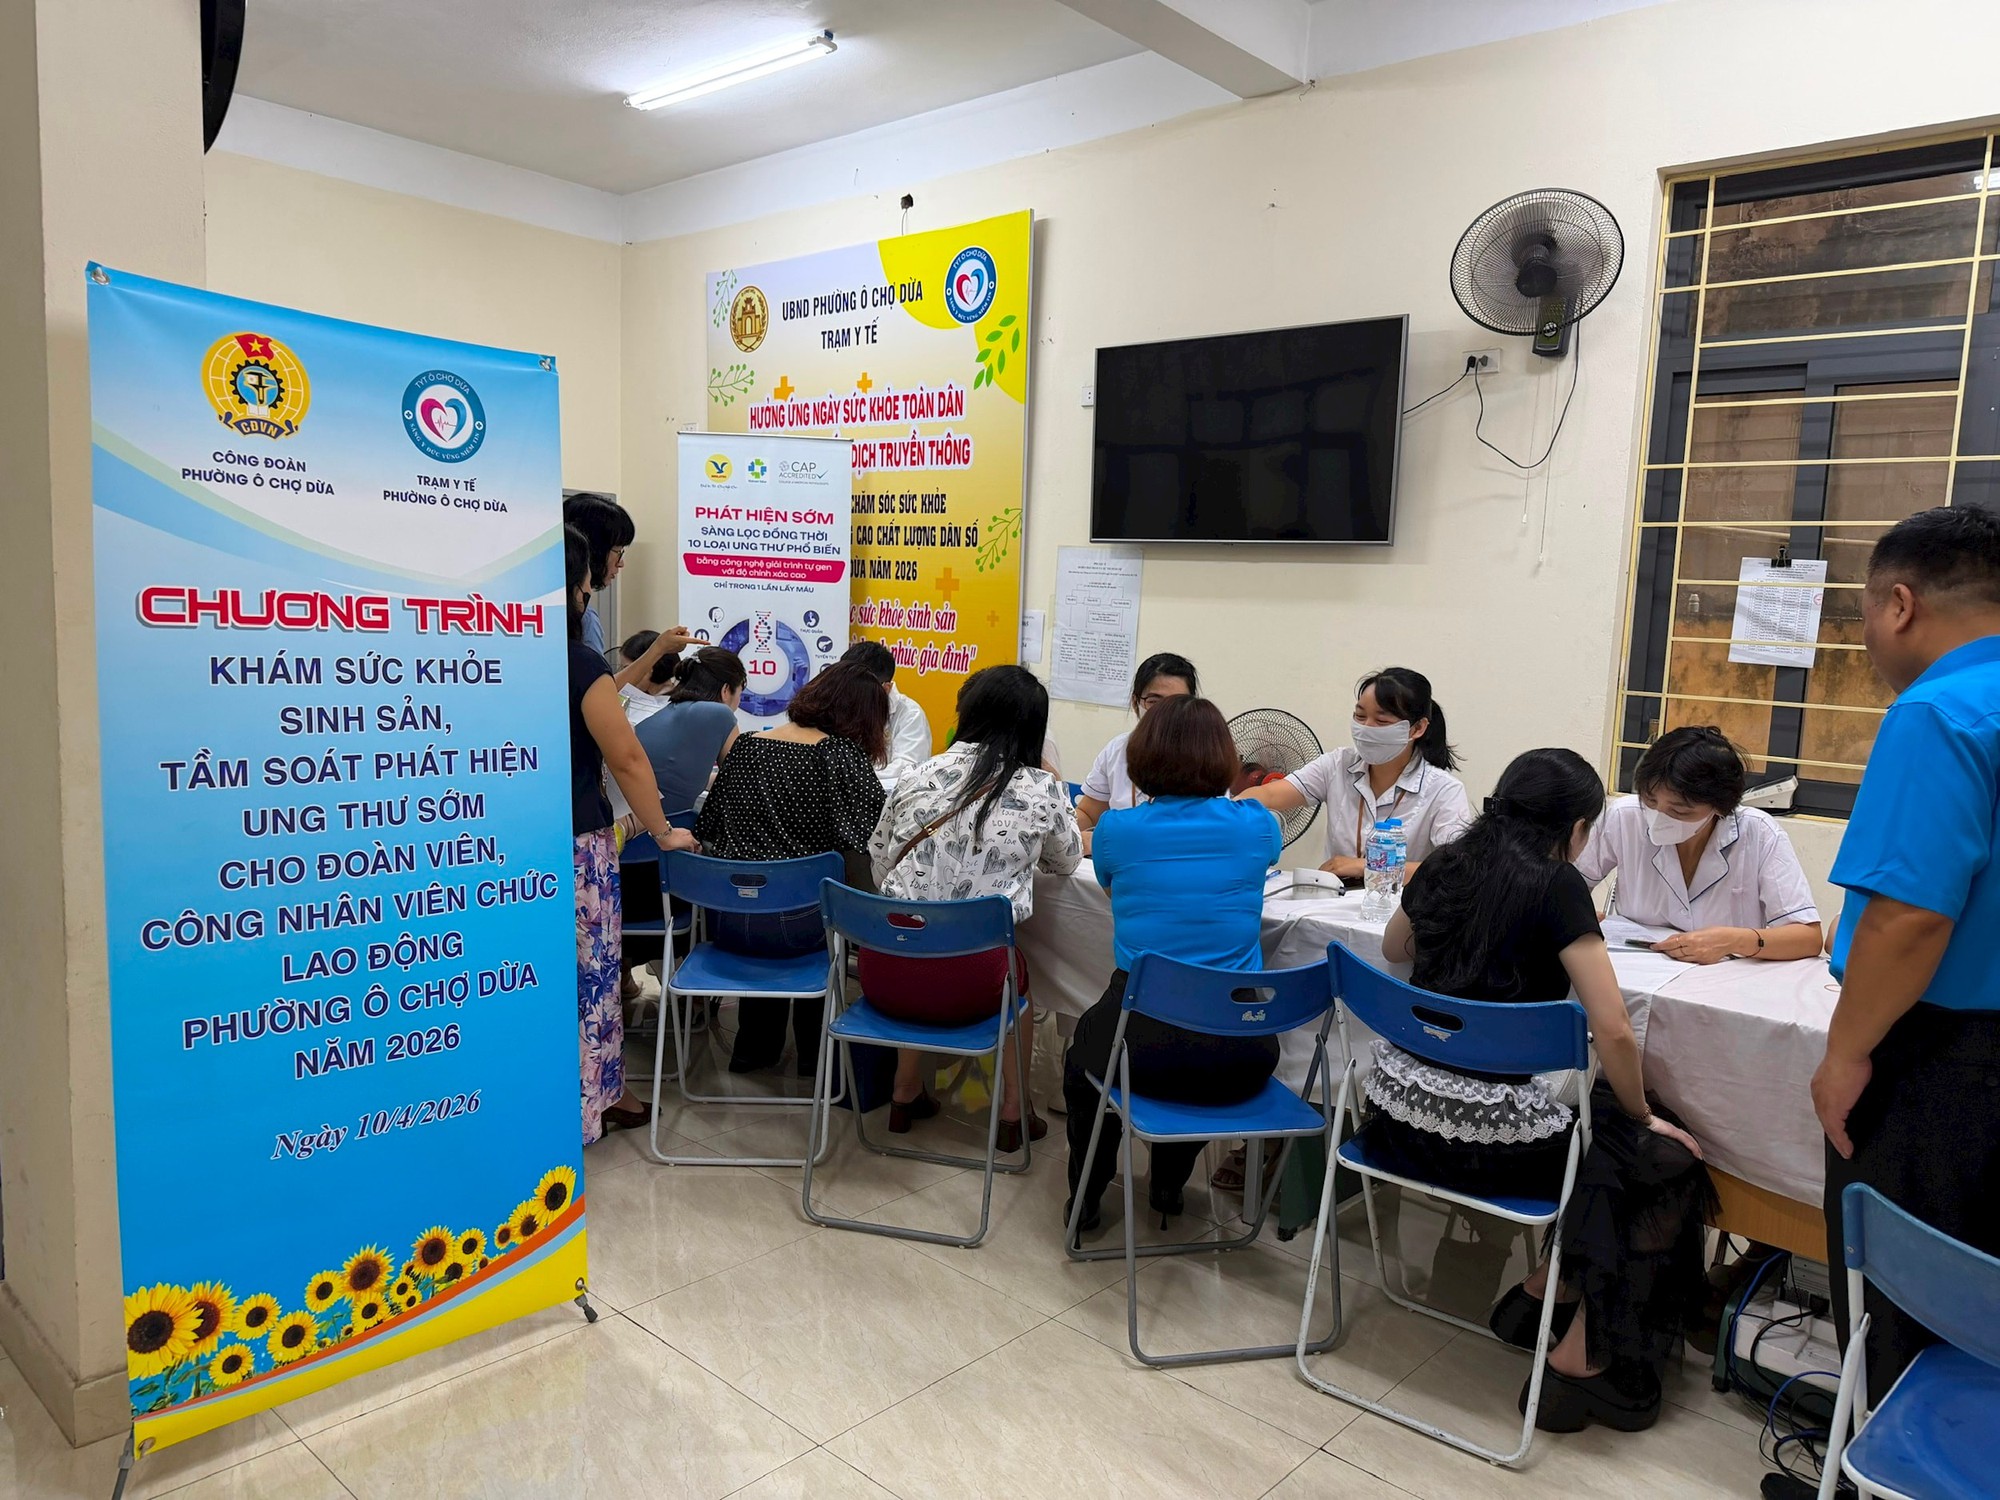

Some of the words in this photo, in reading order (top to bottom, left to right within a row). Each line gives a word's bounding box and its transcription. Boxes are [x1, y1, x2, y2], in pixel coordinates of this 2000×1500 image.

[783, 300, 810, 322] UBND
[813, 288, 856, 317] PHƯỜNG
[861, 284, 868, 309] Ô
[872, 282, 897, 310] CHỢ
[900, 275, 924, 303] DỪA
[821, 329, 851, 352] TRẠM
[854, 327, 862, 345] Y
[865, 318, 878, 344] TẾ
[415, 376, 428, 388] TYT
[428, 373, 435, 381] Ô
[436, 373, 454, 382] CHỢ
[454, 379, 470, 394] DỪA
[788, 397, 810, 427] ỨNG
[813, 394, 840, 425] NGÀY
[843, 392, 866, 424] SỨC
[870, 387, 900, 422] KHỎE
[902, 386, 934, 420] TOÀN
[938, 384, 964, 417] DÂN
[240, 420, 279, 438] CĐVN
[212, 450, 259, 466] CÔNG
[264, 457, 306, 472] ĐOÀN
[791, 462, 817, 472] CAP
[852, 443, 876, 475] DỊCH
[879, 430, 926, 468] TRUYỀN
[928, 432, 970, 466] THÔNG
[182, 468, 248, 485] PHƯỜNG
[253, 473, 264, 487] Ô
[269, 478, 302, 494] CHỢ
[306, 479, 335, 495] DỪA
[416, 474, 449, 491] TRẠM
[452, 478, 461, 489] Y
[463, 476, 477, 492] TẾ
[779, 472, 817, 480] ACCREDITED
[383, 489, 438, 507] PHƯỜNG
[440, 492, 450, 507] Ô
[453, 496, 481, 513] CHỢ
[483, 496, 508, 513] DỪA
[695, 505, 742, 520] PHÁT
[746, 507, 788, 525] HIỆN
[792, 509, 834, 525] SỚM
[878, 490, 896, 514] SÓC
[899, 490, 917, 514] SỨC
[920, 487, 946, 514] KHỎE
[688, 540, 702, 548] 10
[704, 540, 730, 551] LOẠI
[733, 542, 758, 551] UNG
[760, 543, 786, 552] THƯ
[786, 541, 811, 554] PHỔ
[814, 544, 841, 555] BIẾN
[701, 525, 734, 537] SÀNG
[737, 528, 760, 540] LỌC
[800, 530, 828, 542] THỜI
[856, 526, 874, 546] CAO
[877, 518, 900, 546] CHẤT
[904, 526, 936, 550] LƯỢNG
[940, 522, 962, 547] DÂN
[965, 518, 978, 548] SỐ
[720, 558, 742, 567] công
[744, 560, 764, 569] nghệ
[783, 561, 803, 570] trình
[805, 562, 814, 570] tự
[816, 564, 832, 572] gen
[736, 568, 746, 577] độ
[749, 568, 772, 578] chính
[772, 570, 788, 578] xác
[869, 556, 892, 580] NĂM
[895, 560, 917, 581] 2026
[729, 582, 756, 590] TRONG
[796, 585, 814, 593] MÁU
[139, 586, 390, 632] CHƯƠNG
[405, 592, 545, 635] TRÌNH
[858, 599, 876, 625] sức
[878, 600, 904, 627] khỏe
[906, 602, 931, 630] sinh
[934, 604, 956, 632] sản
[210, 650, 322, 686] KHÁM
[335, 650, 403, 686] SỨC
[415, 649, 502, 685] KHỎE
[748, 660, 776, 676] 10
[920, 642, 938, 674] gia
[279, 705, 365, 735] SINH
[376, 695, 453, 735] SẢN,
[160, 747, 248, 792] TẦM
[263, 744, 362, 787] SOÁT
[374, 744, 459, 780] PHÁT
[470, 741, 538, 778] HIỆN
[242, 805, 327, 837] UNG
[338, 795, 409, 830] THƯ
[418, 789, 485, 823] SỚM
[992, 820, 1018, 829] LOVE
[218, 855, 307, 891] CHO
[317, 841, 415, 881] ĐOÀN
[425, 834, 505, 868] VIÊN,
[141, 910, 264, 951] CÔNG
[278, 895, 382, 934] NHÂN
[394, 883, 467, 920] VIÊN
[476, 869, 558, 908] CHỨC
[282, 946, 358, 984] LAO
[368, 931, 464, 971] ĐỘNG
[182, 996, 351, 1049] PHƯỜNG
[362, 984, 390, 1018] Ô
[399, 973, 470, 1009] CHỢ
[478, 961, 539, 998] DỪA
[294, 1037, 375, 1079] NĂM
[386, 1023, 461, 1061] 2026
[271, 1123, 348, 1160] Ngày
[354, 1089, 481, 1140] 10/4/2026
